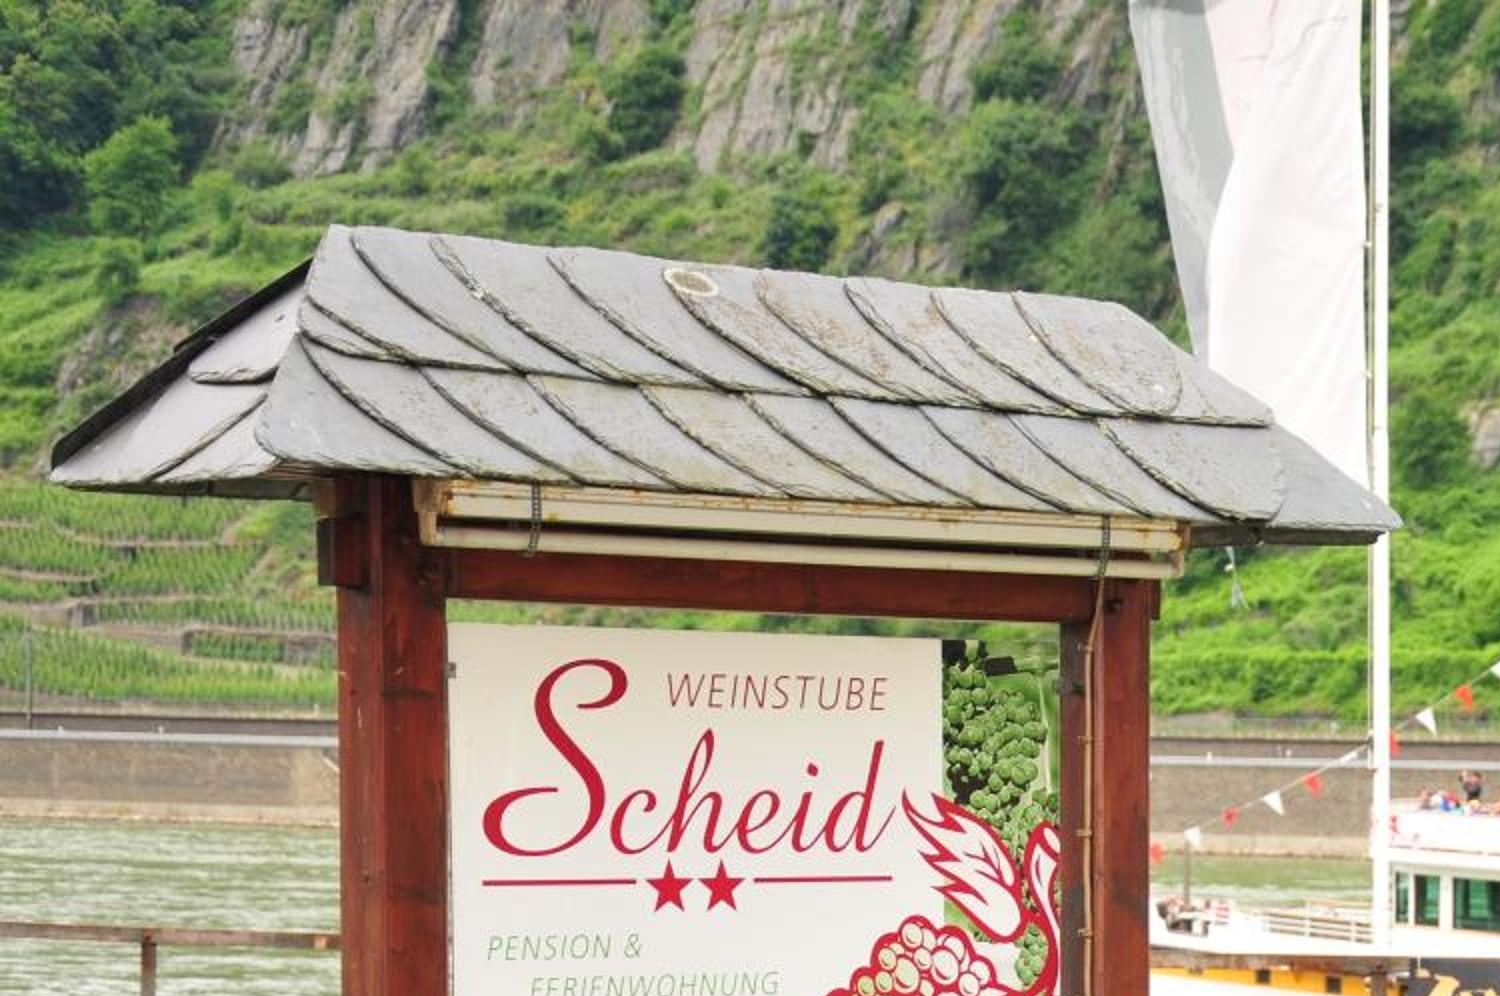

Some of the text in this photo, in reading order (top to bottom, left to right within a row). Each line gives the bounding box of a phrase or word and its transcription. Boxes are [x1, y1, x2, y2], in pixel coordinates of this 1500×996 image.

[667, 673, 889, 711] WEINSTUBE
[481, 658, 897, 857] Scheid
[486, 932, 643, 962] PENSION &
